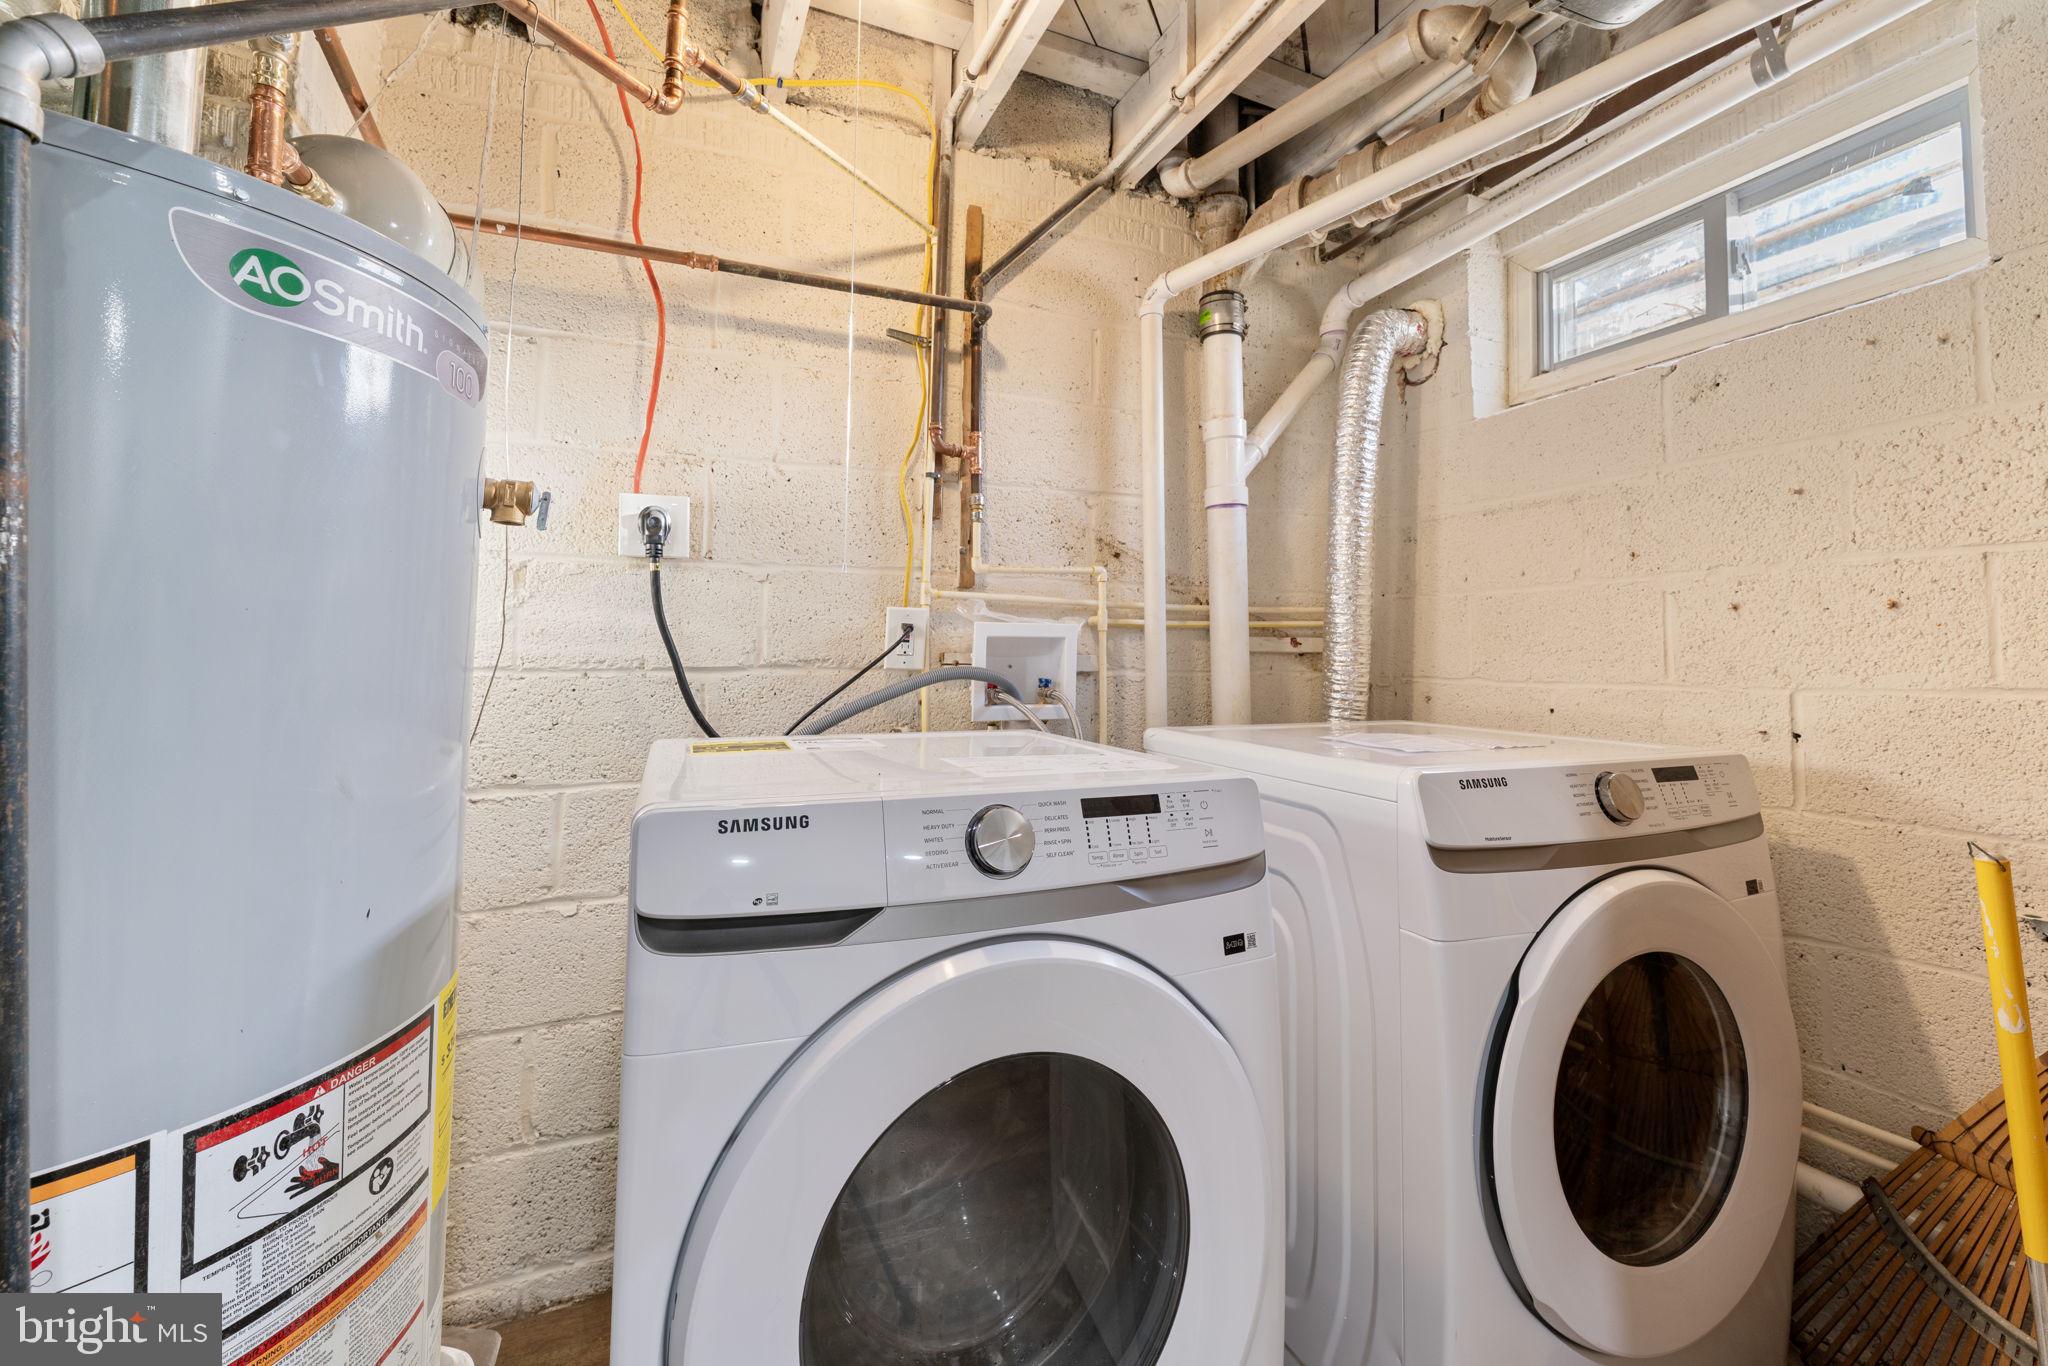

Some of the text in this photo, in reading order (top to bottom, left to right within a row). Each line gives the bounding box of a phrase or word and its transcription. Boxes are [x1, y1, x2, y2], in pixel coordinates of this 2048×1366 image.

[450, 361, 473, 399] 100
[1459, 776, 1508, 790] SAMSUNG
[718, 814, 810, 834] SAMSUNG
[330, 1056, 376, 1089] DANGER
[262, 1231, 276, 1241] TIME
[288, 1208, 314, 1226] PRODUCE
[284, 1226, 293, 1235] ON
[293, 1215, 311, 1229] ADULT
[202, 1252, 250, 1280] TEMPERATURE
[229, 1245, 252, 1260] WATER
[222, 1259, 306, 1314] ermostatic Mixing Valves
